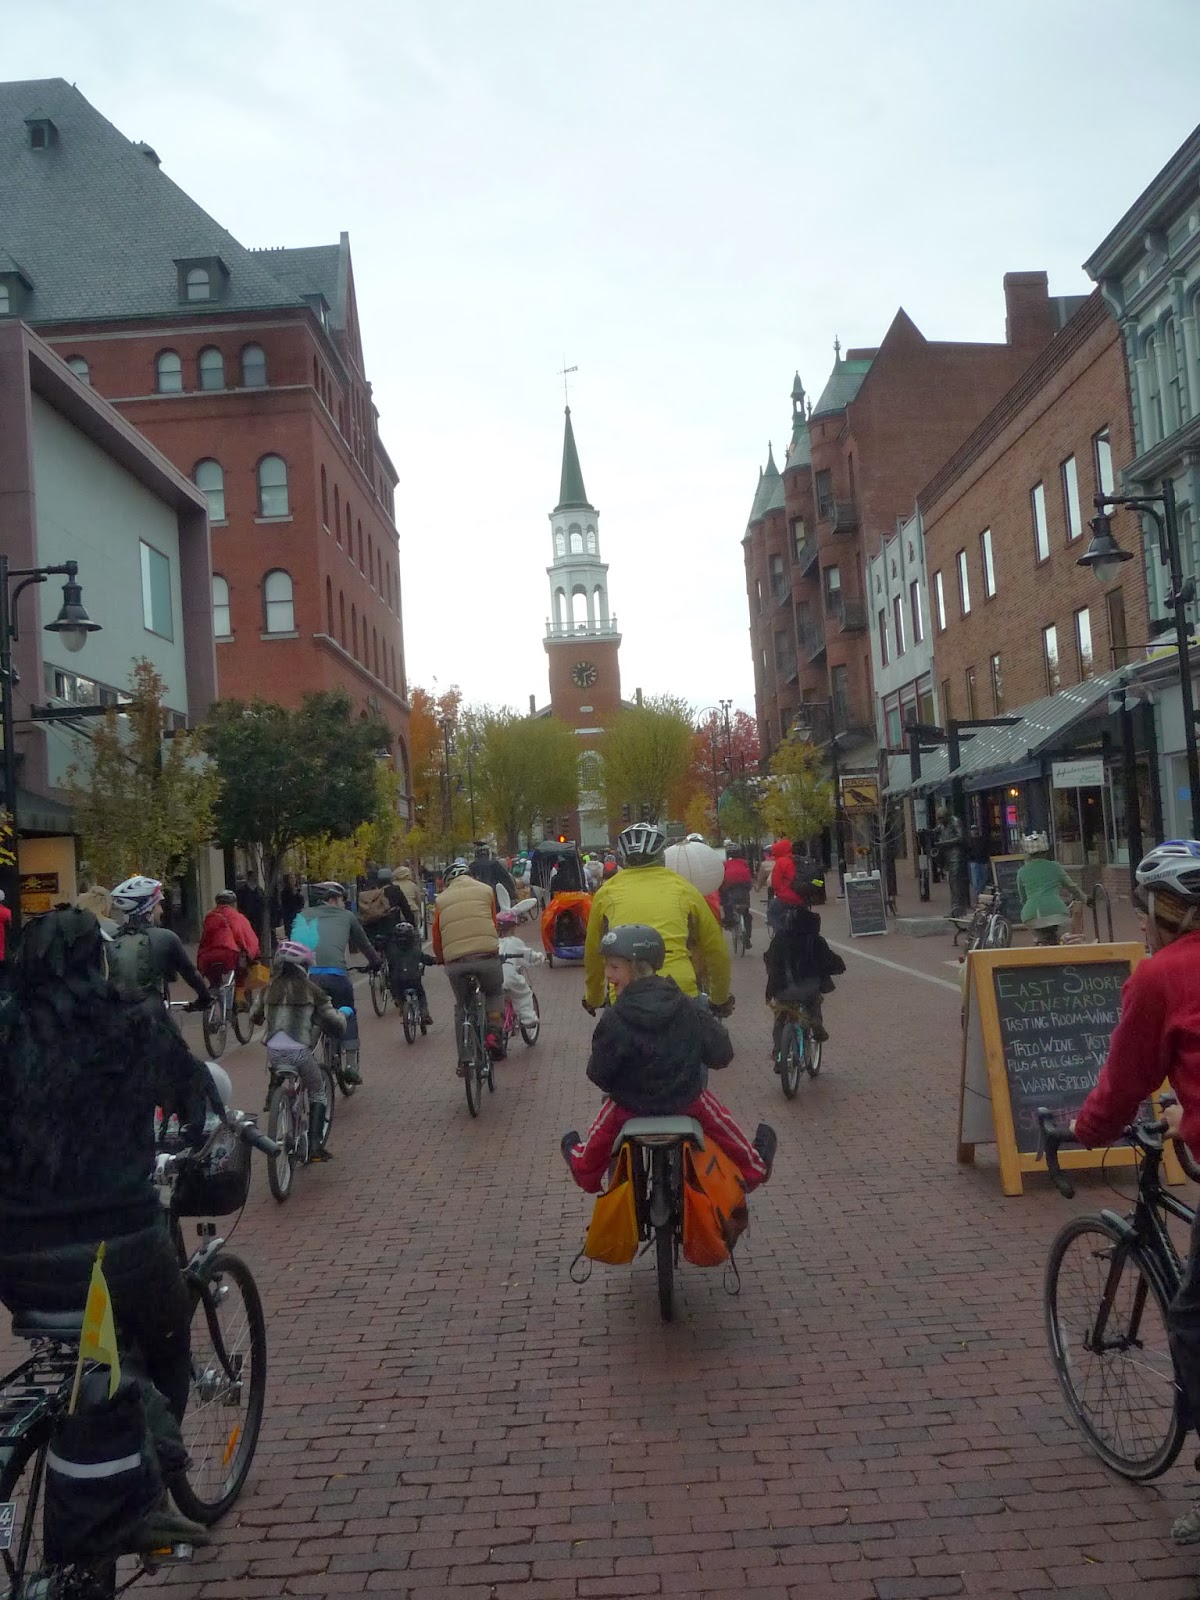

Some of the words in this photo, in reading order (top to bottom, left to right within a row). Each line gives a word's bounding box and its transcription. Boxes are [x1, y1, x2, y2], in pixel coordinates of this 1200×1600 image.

[845, 778, 875, 786] CROW
[997, 973, 1055, 998] EAST
[1063, 966, 1123, 994] SHORE
[1002, 1016, 1049, 1032] TASTING
[1039, 1036, 1076, 1053] WINE
[1040, 1056, 1059, 1069] FULL
[1020, 1076, 1059, 1094] WARM
